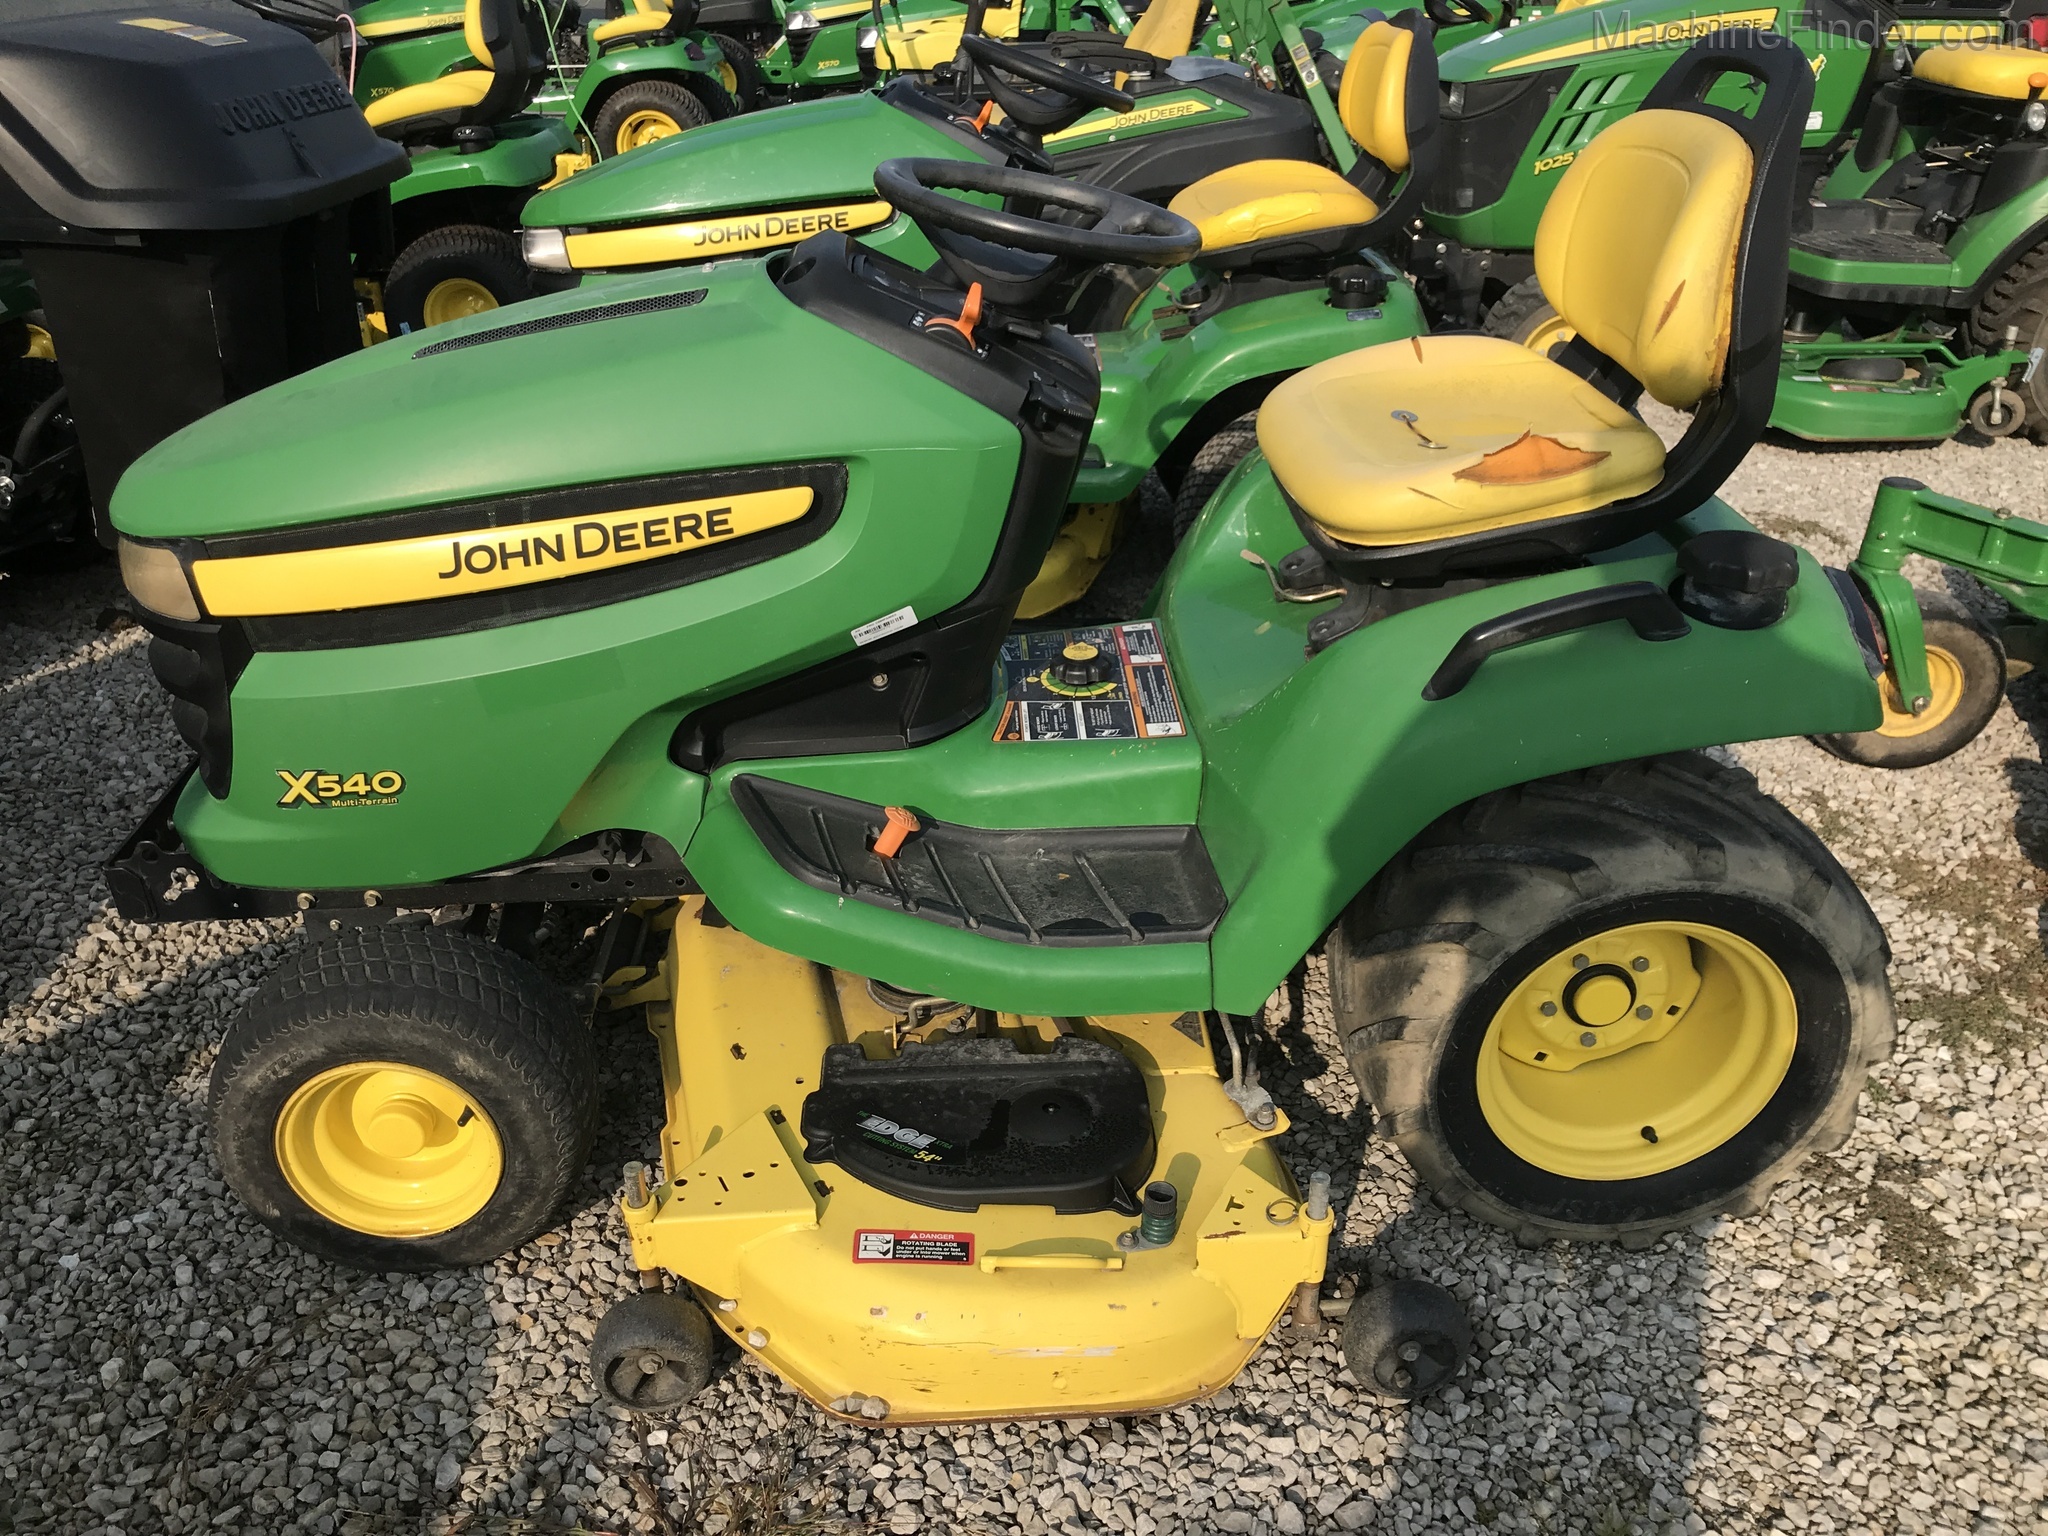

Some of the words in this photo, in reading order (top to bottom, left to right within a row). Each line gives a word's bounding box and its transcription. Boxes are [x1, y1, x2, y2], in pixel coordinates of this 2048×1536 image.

[1658, 24, 1704, 40] JOHN
[214, 94, 285, 136] JOHN
[273, 79, 352, 121] DEERE
[370, 87, 395, 98] X570
[1111, 113, 1147, 129] JOHN
[1149, 104, 1194, 120] DEERE
[1533, 149, 1583, 176] 1025
[693, 222, 761, 247] JOHN
[765, 211, 849, 238] DEERE
[438, 533, 566, 580] JOHN
[573, 506, 735, 560] DEERE
[276, 769, 406, 808] X540
[331, 796, 399, 807] Multi-Terrain
[856, 1113, 938, 1150] EDGE
